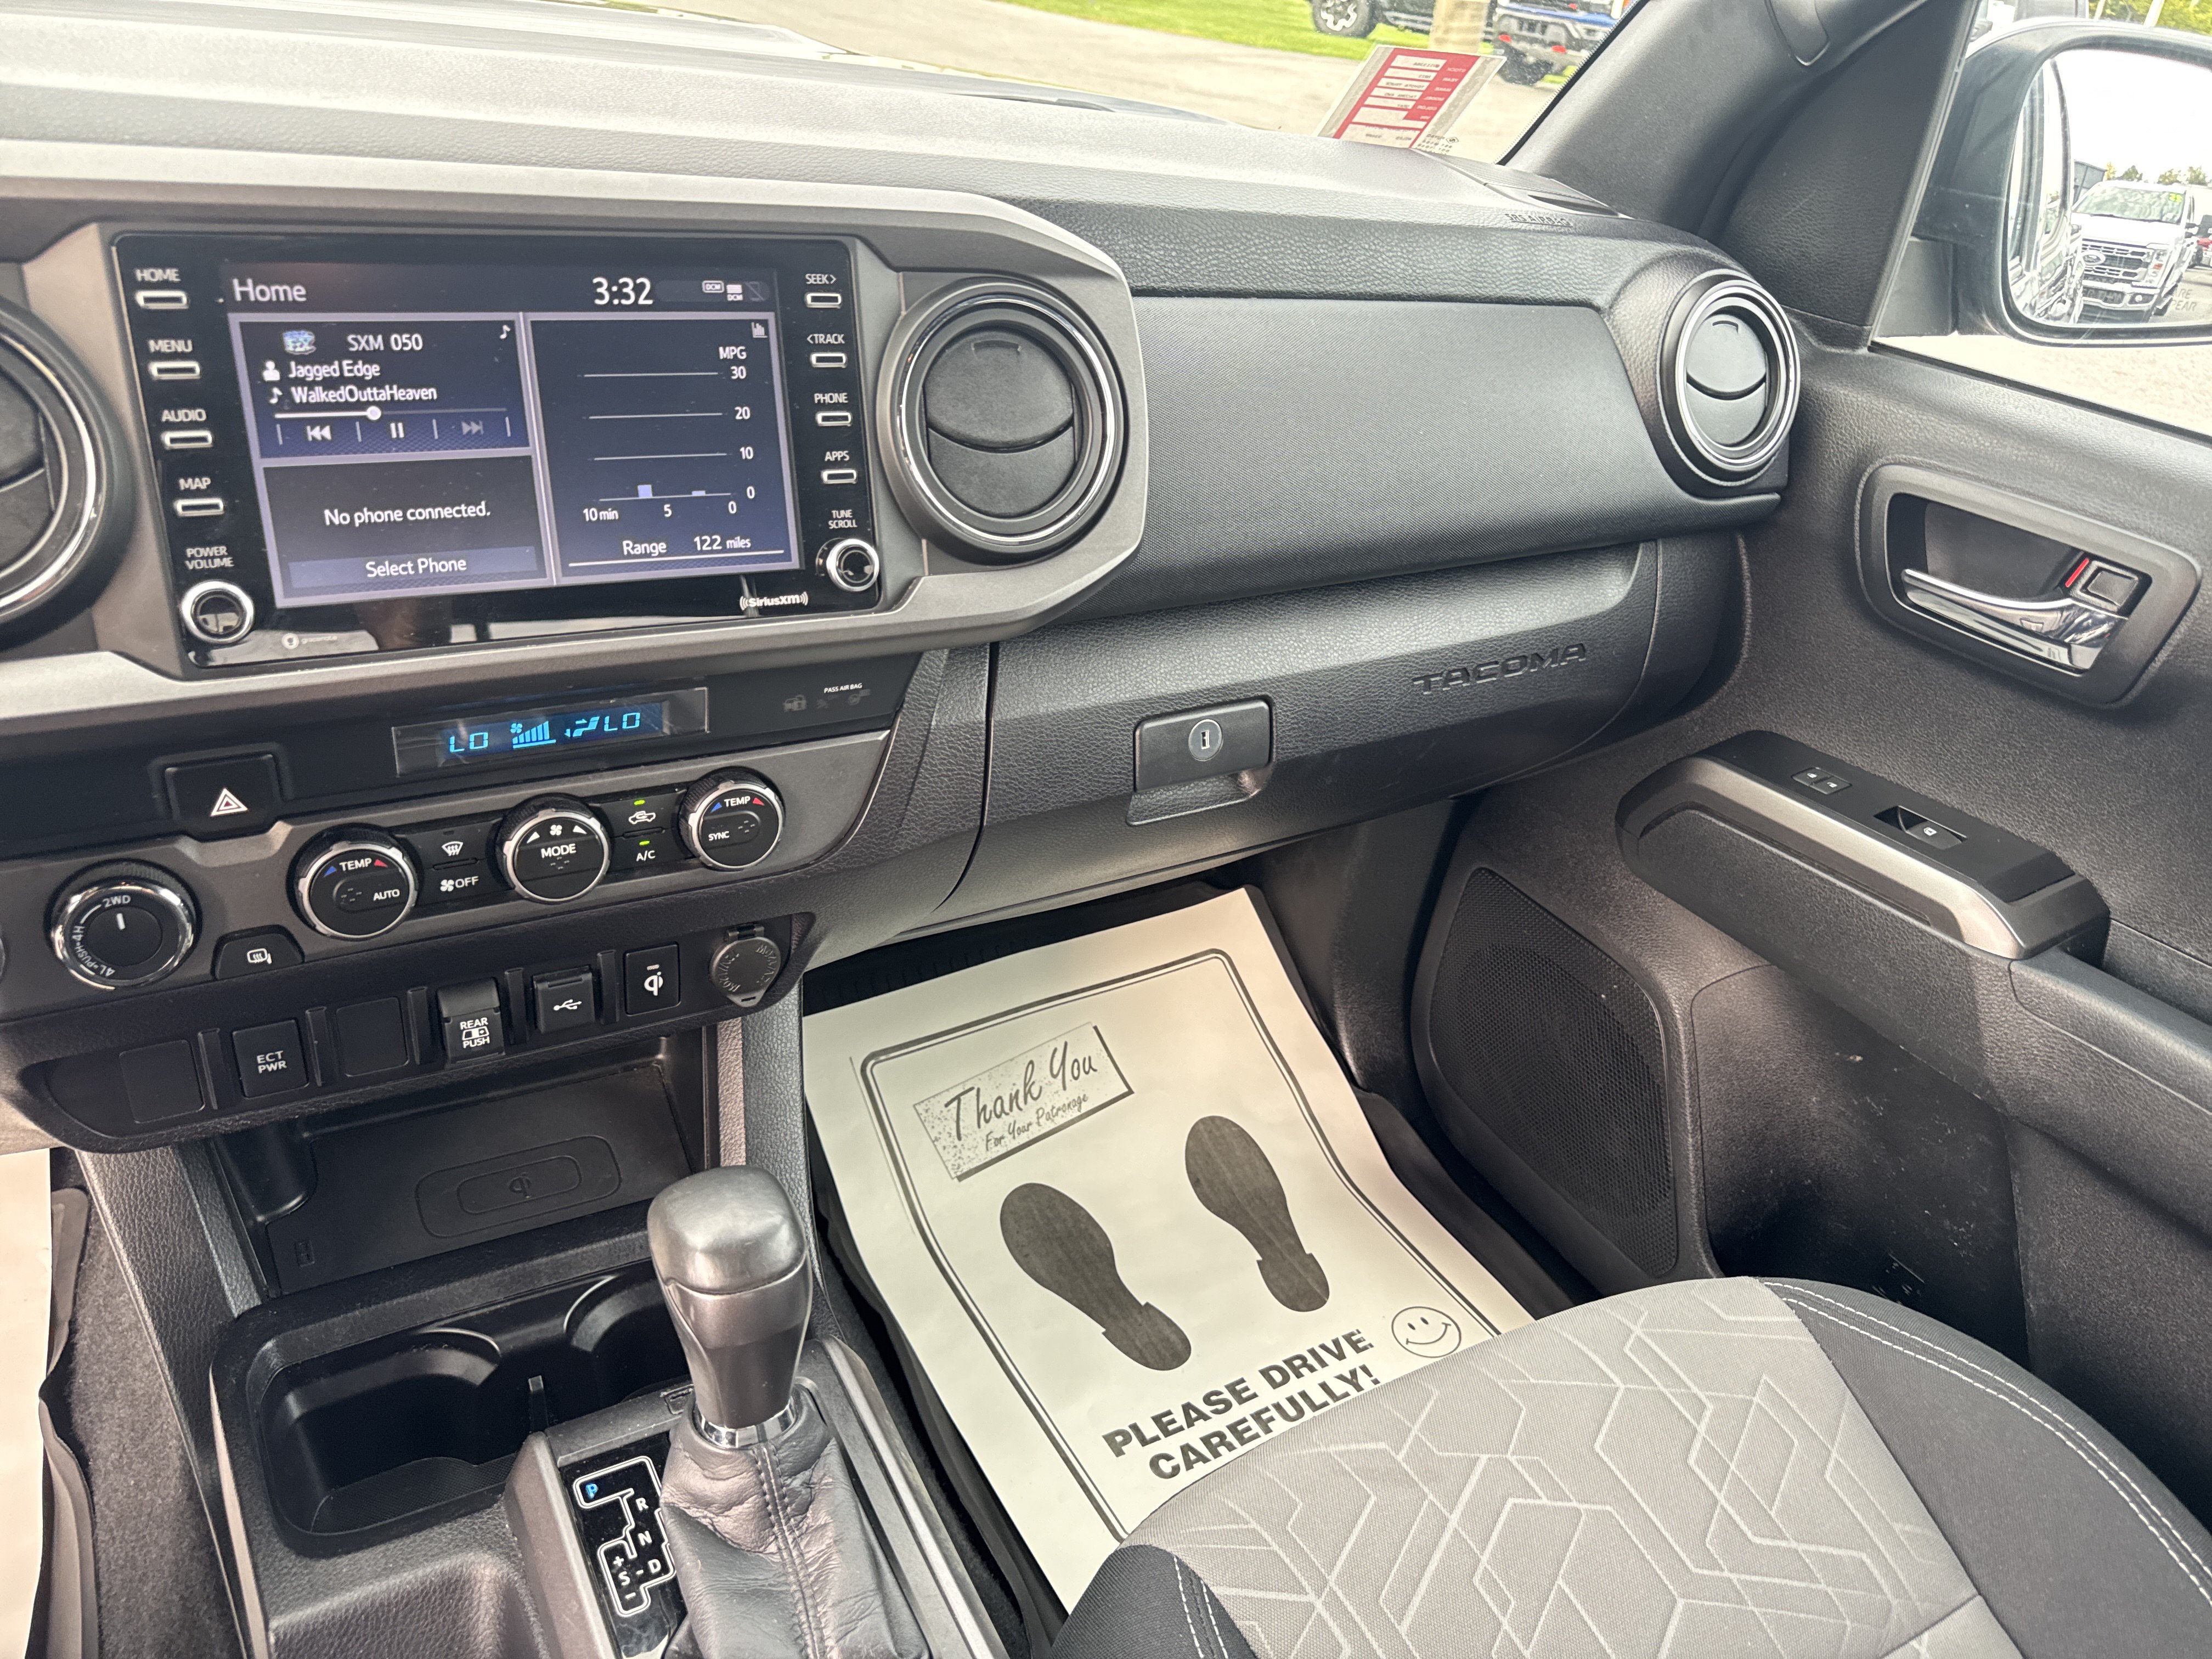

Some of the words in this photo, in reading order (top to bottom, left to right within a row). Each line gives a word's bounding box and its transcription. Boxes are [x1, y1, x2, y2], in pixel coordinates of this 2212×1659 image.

[136, 268, 180, 283] HOME
[233, 278, 306, 302] Home
[592, 276, 653, 305] 3:32
[148, 339, 193, 353] MENU
[347, 335, 383, 351] SXM
[390, 334, 423, 351] 050
[719, 346, 747, 359] MPG
[289, 362, 340, 380] Jagged
[342, 361, 380, 380] Edge
[730, 366, 747, 379] 30
[291, 386, 437, 403] WalkedOuttaHeaven
[814, 393, 848, 403] PHONE
[162, 409, 206, 422] AUDIO
[735, 407, 751, 420] 20
[740, 446, 754, 460] 10
[825, 451, 850, 461] APPS
[179, 478, 211, 490] MAP
[746, 487, 755, 499] 0
[324, 508, 351, 525] No
[354, 506, 403, 527] phone
[407, 501, 491, 521] connected.
[583, 508, 599, 521] 10
[599, 507, 619, 521] min
[664, 504, 672, 517] 5
[728, 501, 737, 514] 0
[832, 510, 853, 519] TUNE
[828, 519, 857, 529] SCROLL
[187, 546, 228, 558] POWER
[622, 539, 667, 557] Range
[693, 536, 722, 551] 122
[726, 535, 751, 549] miles
[184, 556, 234, 569] VOLUME
[365, 560, 415, 577] Select
[417, 557, 467, 575] Phone
[1412, 642, 1586, 695] TACOMA
[724, 795, 751, 807] TEMP
[708, 831, 730, 841] SYNC
[541, 844, 576, 857] MODE
[636, 850, 656, 862] A/C
[339, 857, 373, 871] TEMP
[455, 876, 479, 889] OFF
[103, 895, 131, 908] 2WD
[373, 889, 400, 900] AUTO
[460, 1018, 488, 1030] REAR
[462, 1036, 490, 1048] PUSH
[257, 1051, 283, 1064] ECT
[258, 1060, 287, 1074] PWR
[944, 1059, 1042, 1141] Thank
[1049, 1041, 1097, 1091] You
[986, 1133, 1005, 1151] For
[1008, 1120, 1032, 1139] Your
[1036, 1094, 1088, 1127] Patronage
[1102, 1377, 1259, 1457] PLEASE
[1259, 1329, 1374, 1390] DRIVE
[1149, 1364, 1381, 1479] CAREFULLY!
[585, 1483, 598, 1499] P
[636, 1497, 648, 1511] R
[637, 1531, 652, 1546] N
[618, 1571, 630, 1586] S
[648, 1559, 661, 1574] D
